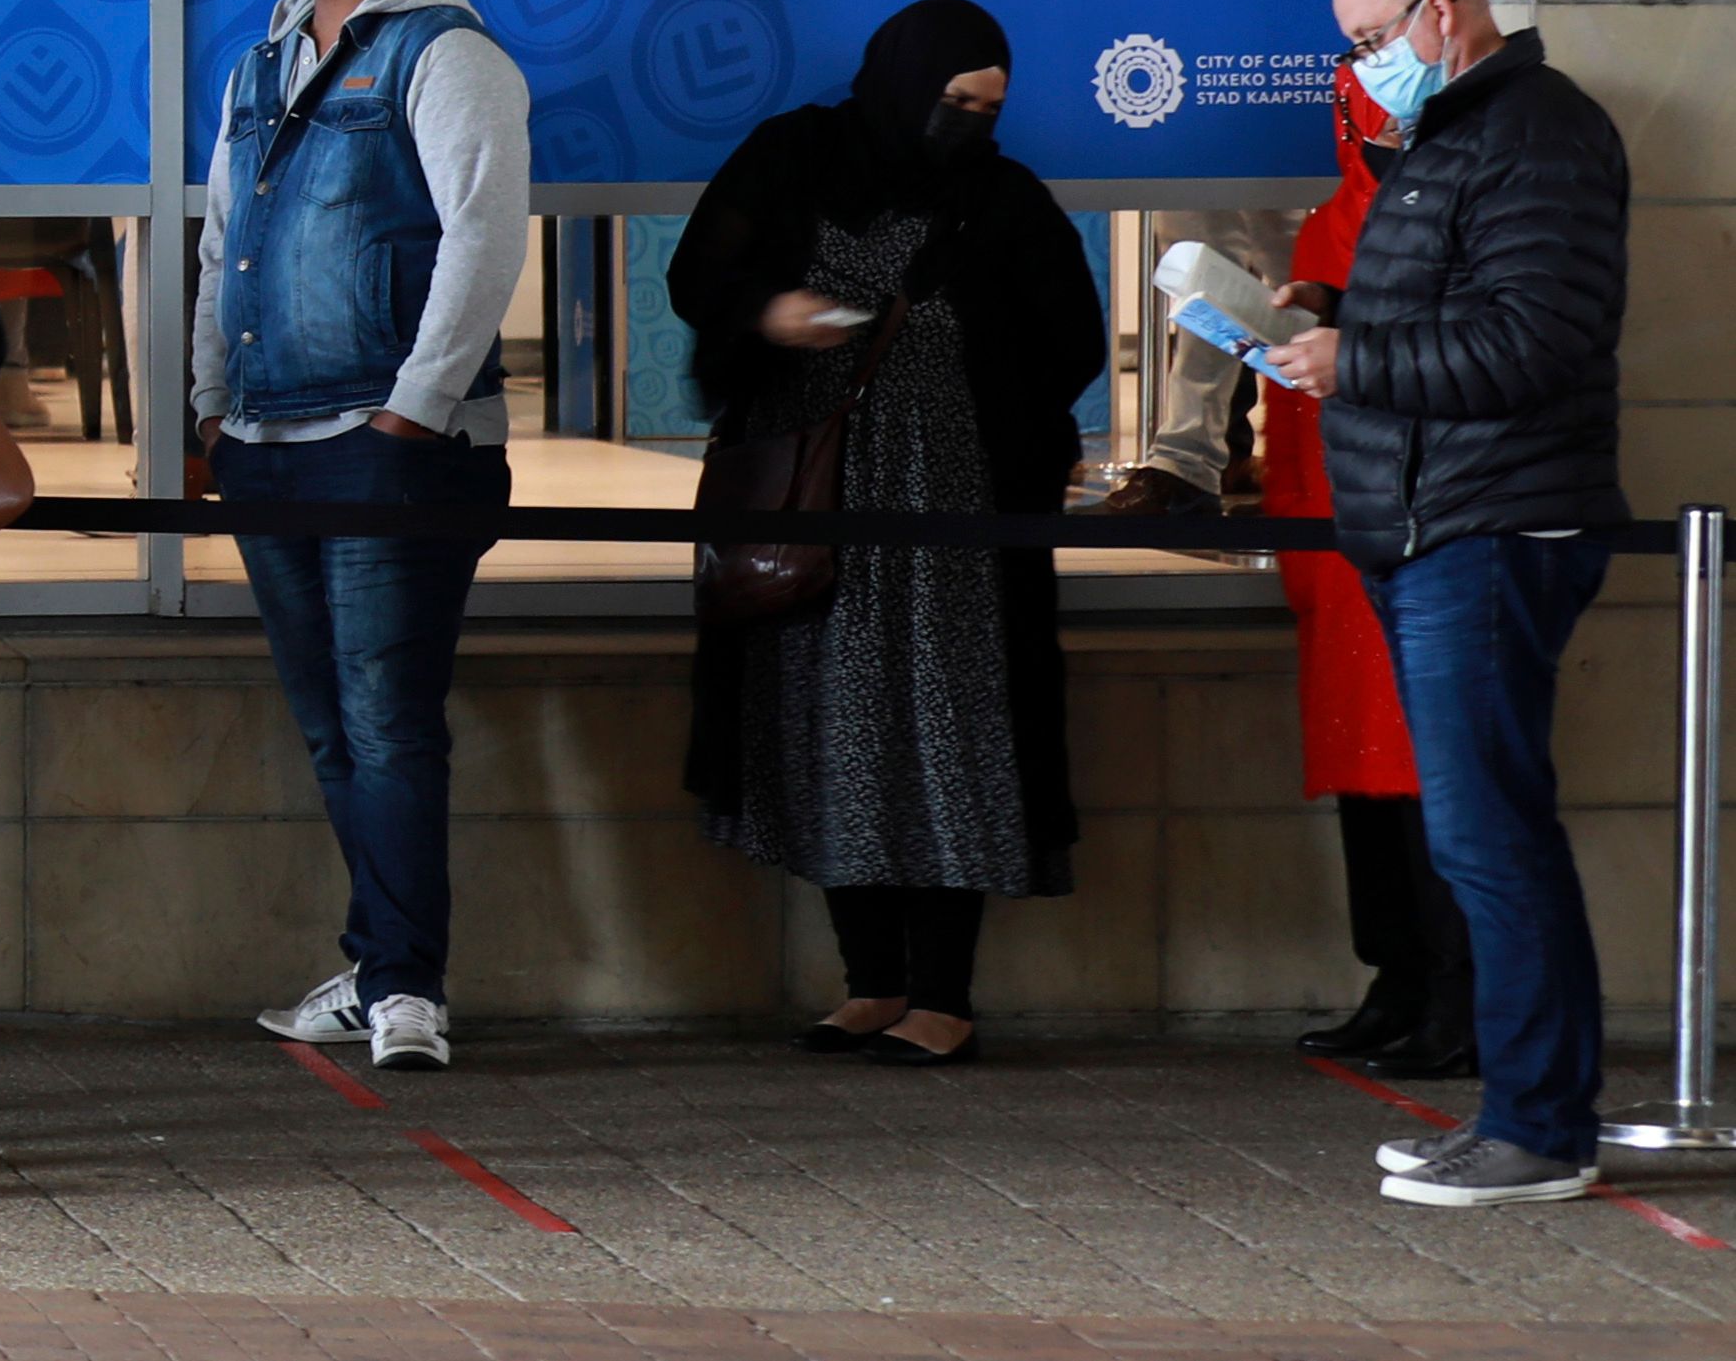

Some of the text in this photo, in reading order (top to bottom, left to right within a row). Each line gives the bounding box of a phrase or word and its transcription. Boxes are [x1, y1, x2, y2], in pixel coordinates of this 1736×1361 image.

[1196, 55, 1234, 69] CITY
[1239, 55, 1264, 69] OF
[1269, 54, 1315, 68] CAPE
[1196, 73, 1266, 87] ISIXEKO
[1196, 90, 1336, 105] STAD KAAPSTAD
